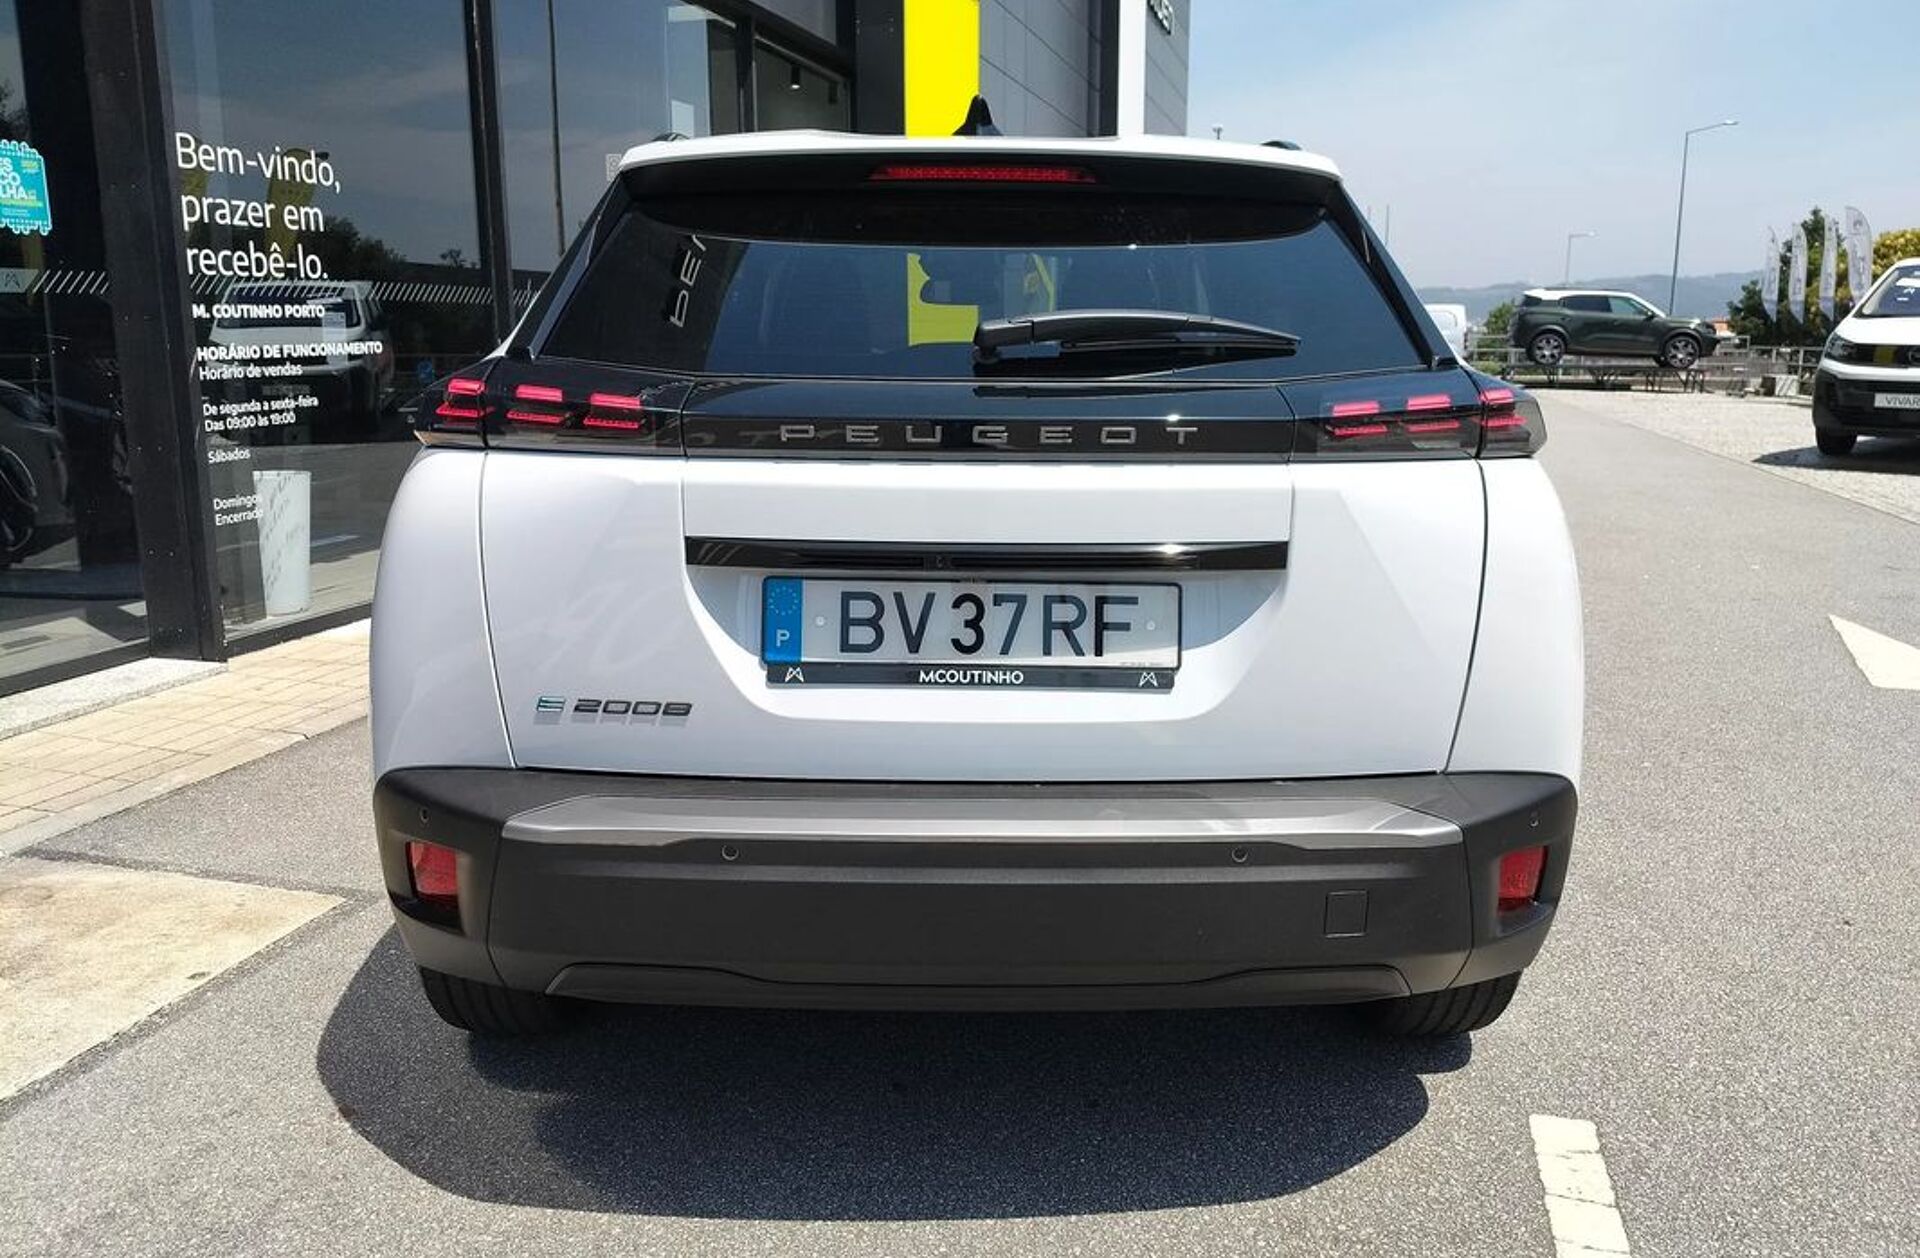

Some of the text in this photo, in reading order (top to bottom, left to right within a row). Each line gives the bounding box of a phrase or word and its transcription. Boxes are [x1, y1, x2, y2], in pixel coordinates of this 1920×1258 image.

[175, 132, 341, 194] Bem-vindo,
[181, 194, 325, 232] prazer em
[186, 240, 329, 279] recebê-lo.
[192, 304, 325, 319] M. COUTINHO PORTO
[197, 341, 383, 362] HORÁRIO DE FUNCIONAMENTO
[200, 361, 303, 380] Horário de vendas
[203, 395, 319, 416] De segunda a sexta-feira
[205, 420, 225, 432] Das
[780, 425, 1199, 445] PEUGEOT
[208, 447, 251, 464] Sábados
[776, 629, 790, 647] P
[919, 669, 1024, 685] MCOUTINHO
[573, 698, 693, 717] 2008
